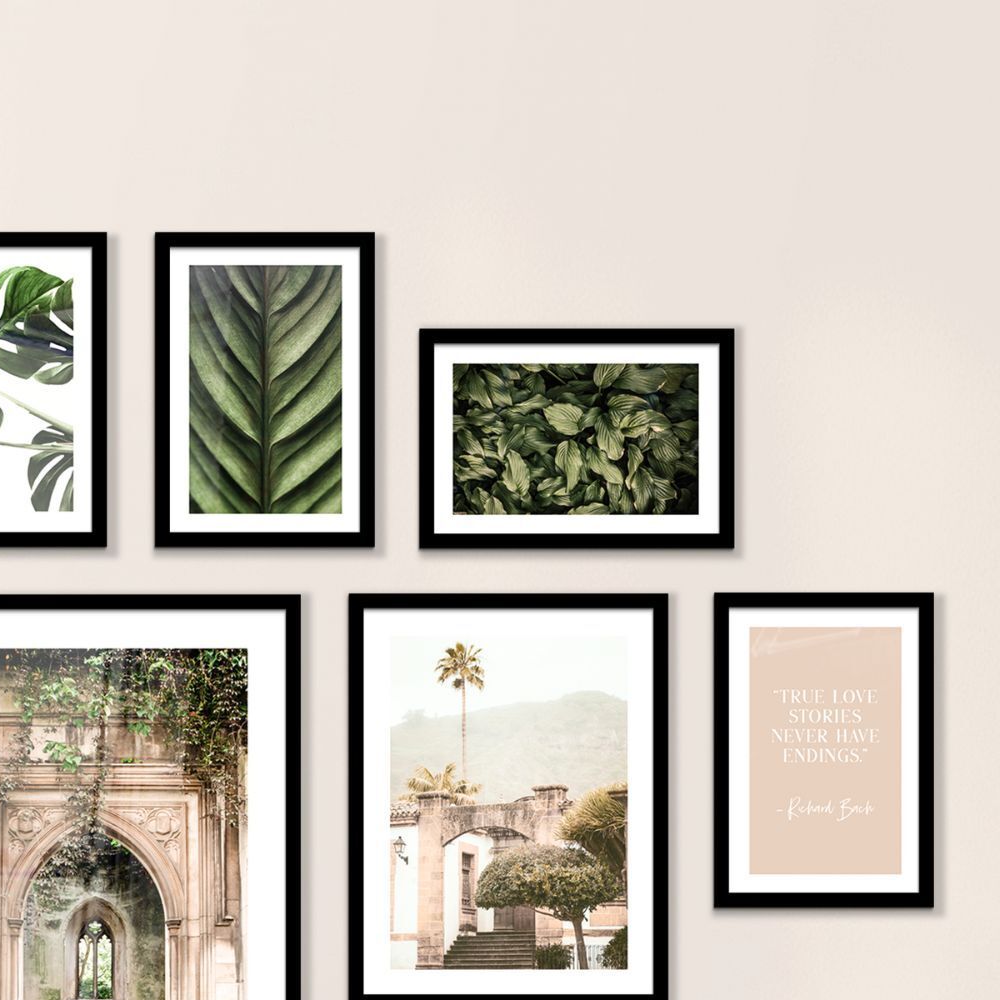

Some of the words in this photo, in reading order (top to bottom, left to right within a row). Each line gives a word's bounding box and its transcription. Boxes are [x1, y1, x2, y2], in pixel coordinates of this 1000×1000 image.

[833, 688, 878, 704] LOVE
[788, 708, 862, 724] STORIES
[771, 728, 828, 743] NEVER
[836, 728, 880, 743] HAVE
